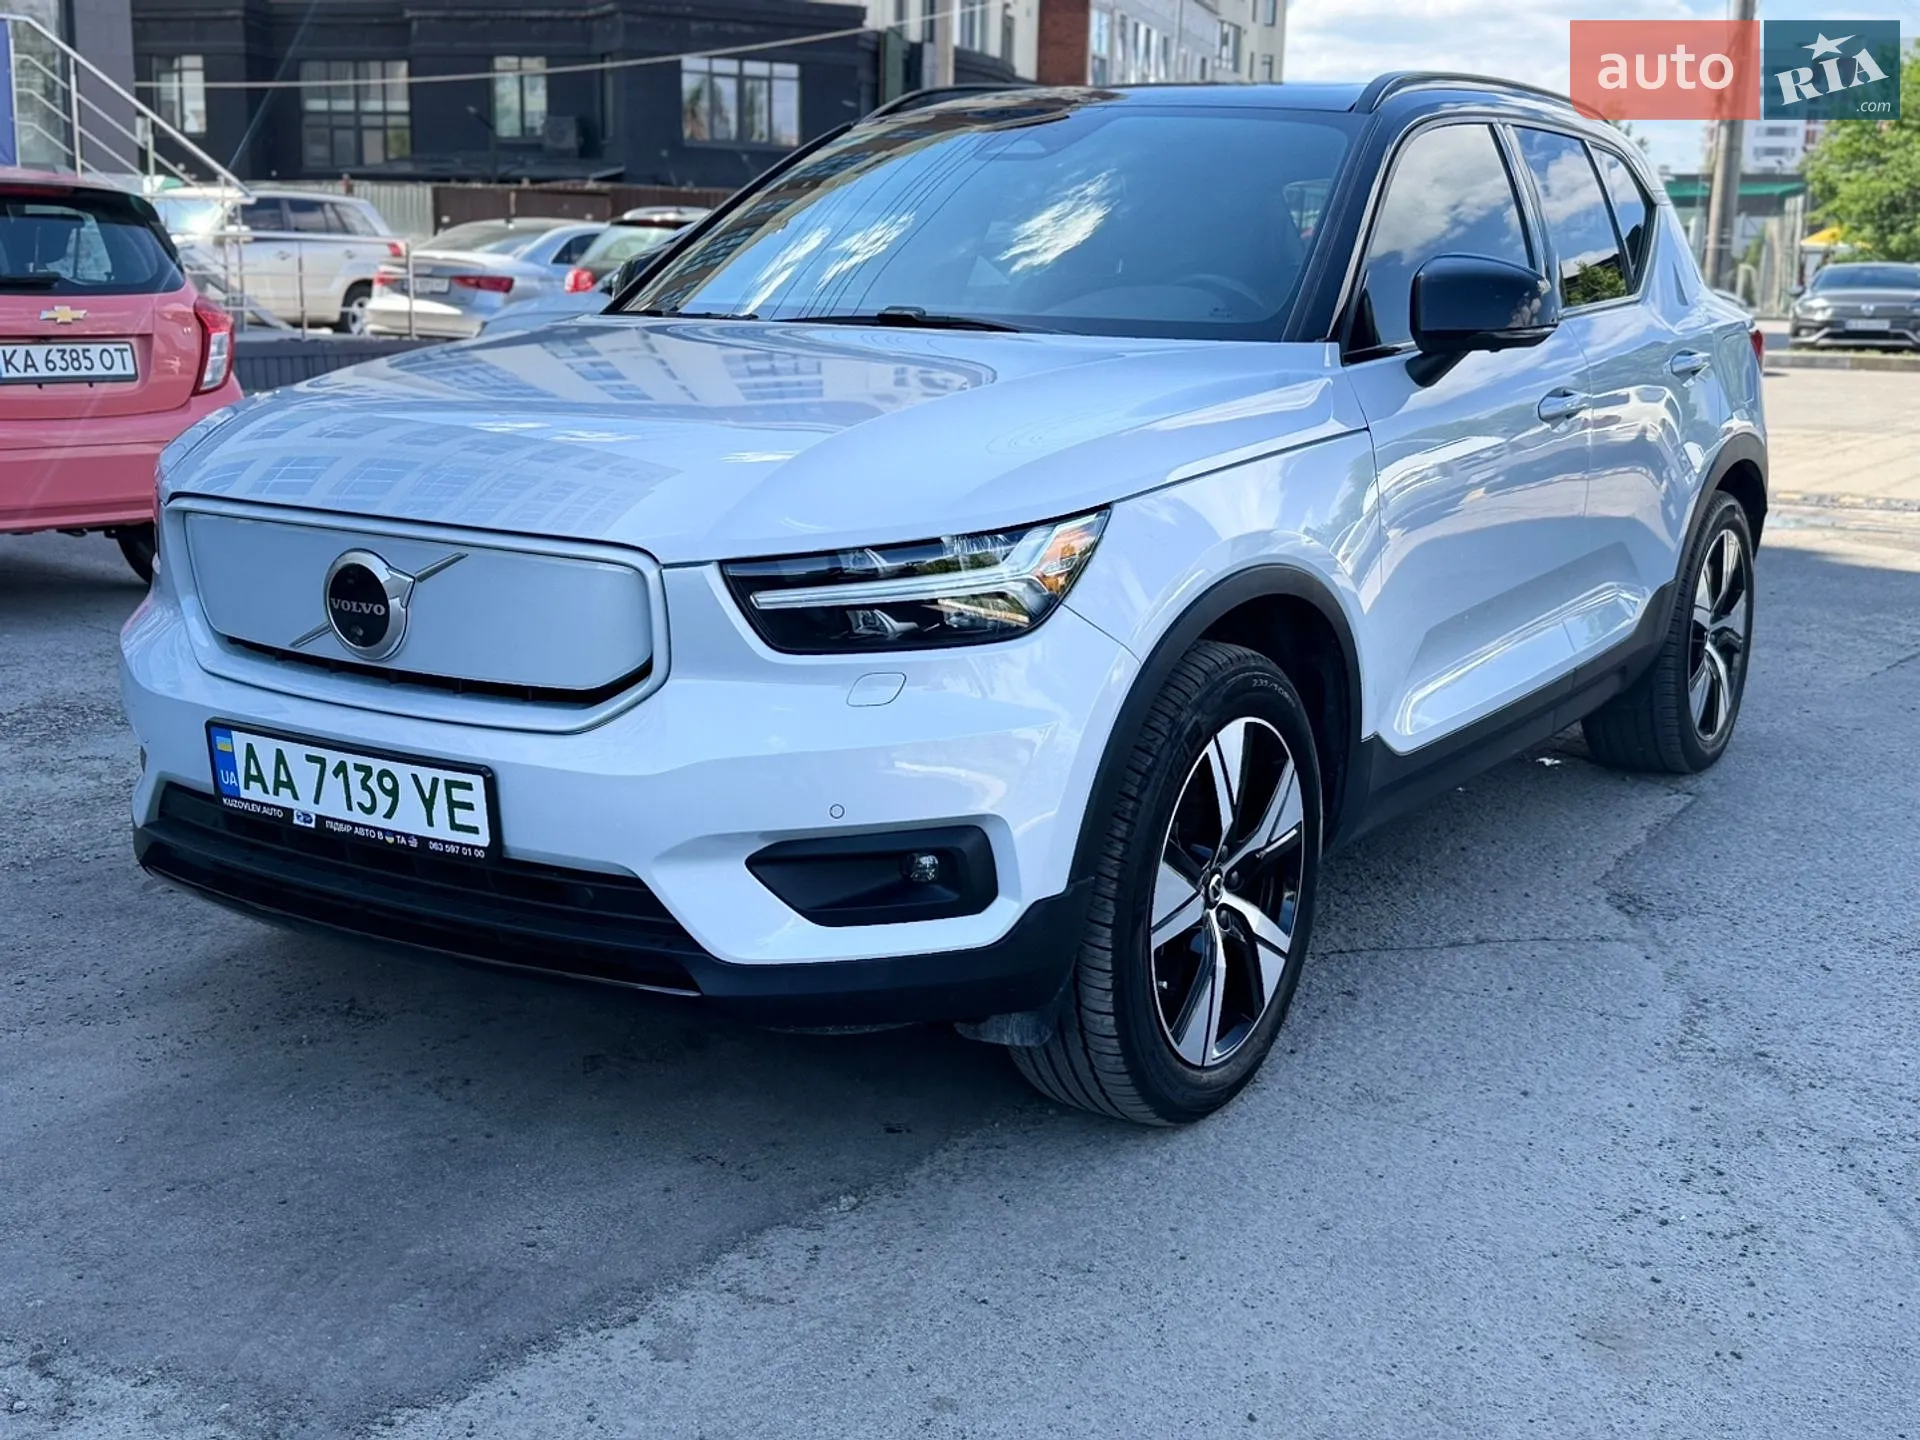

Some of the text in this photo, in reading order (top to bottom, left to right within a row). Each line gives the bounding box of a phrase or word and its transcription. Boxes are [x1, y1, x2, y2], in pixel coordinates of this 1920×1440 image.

[2, 348, 128, 374] KA 6385 OT
[330, 597, 386, 616] VOLVO
[220, 769, 239, 787] UA
[243, 742, 480, 835] AA 7139 YE
[461, 847, 472, 857] 01
[473, 848, 486, 858] 00
